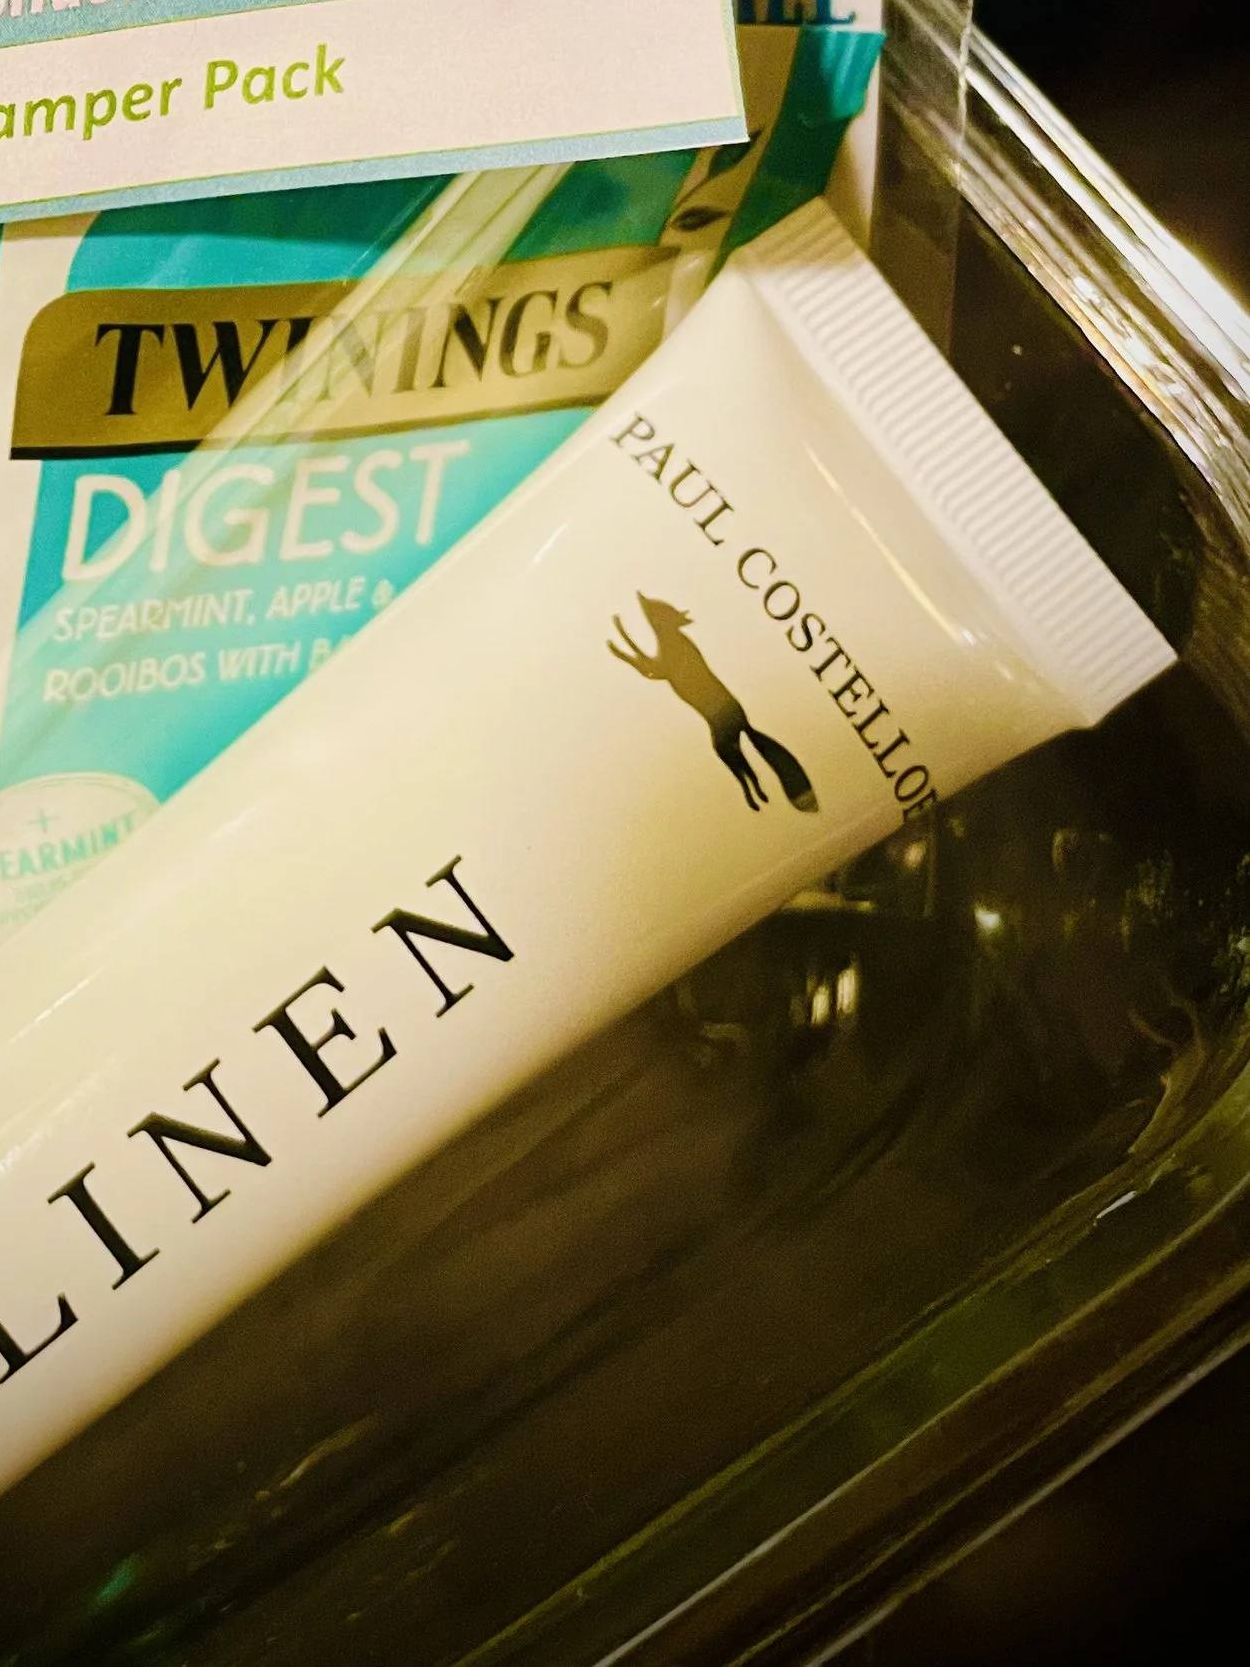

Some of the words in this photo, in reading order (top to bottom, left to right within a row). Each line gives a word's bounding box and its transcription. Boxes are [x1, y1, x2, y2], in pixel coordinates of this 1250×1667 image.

[203, 44, 347, 109] Pack
[95, 280, 614, 416] TWININGS
[61, 441, 472, 583] DIGEST
[609, 413, 735, 546] PAUL
[52, 588, 255, 642] SPEARMINT,
[265, 575, 366, 621] APPLE
[43, 651, 207, 702] ROOIBOS
[217, 639, 302, 681] WITH
